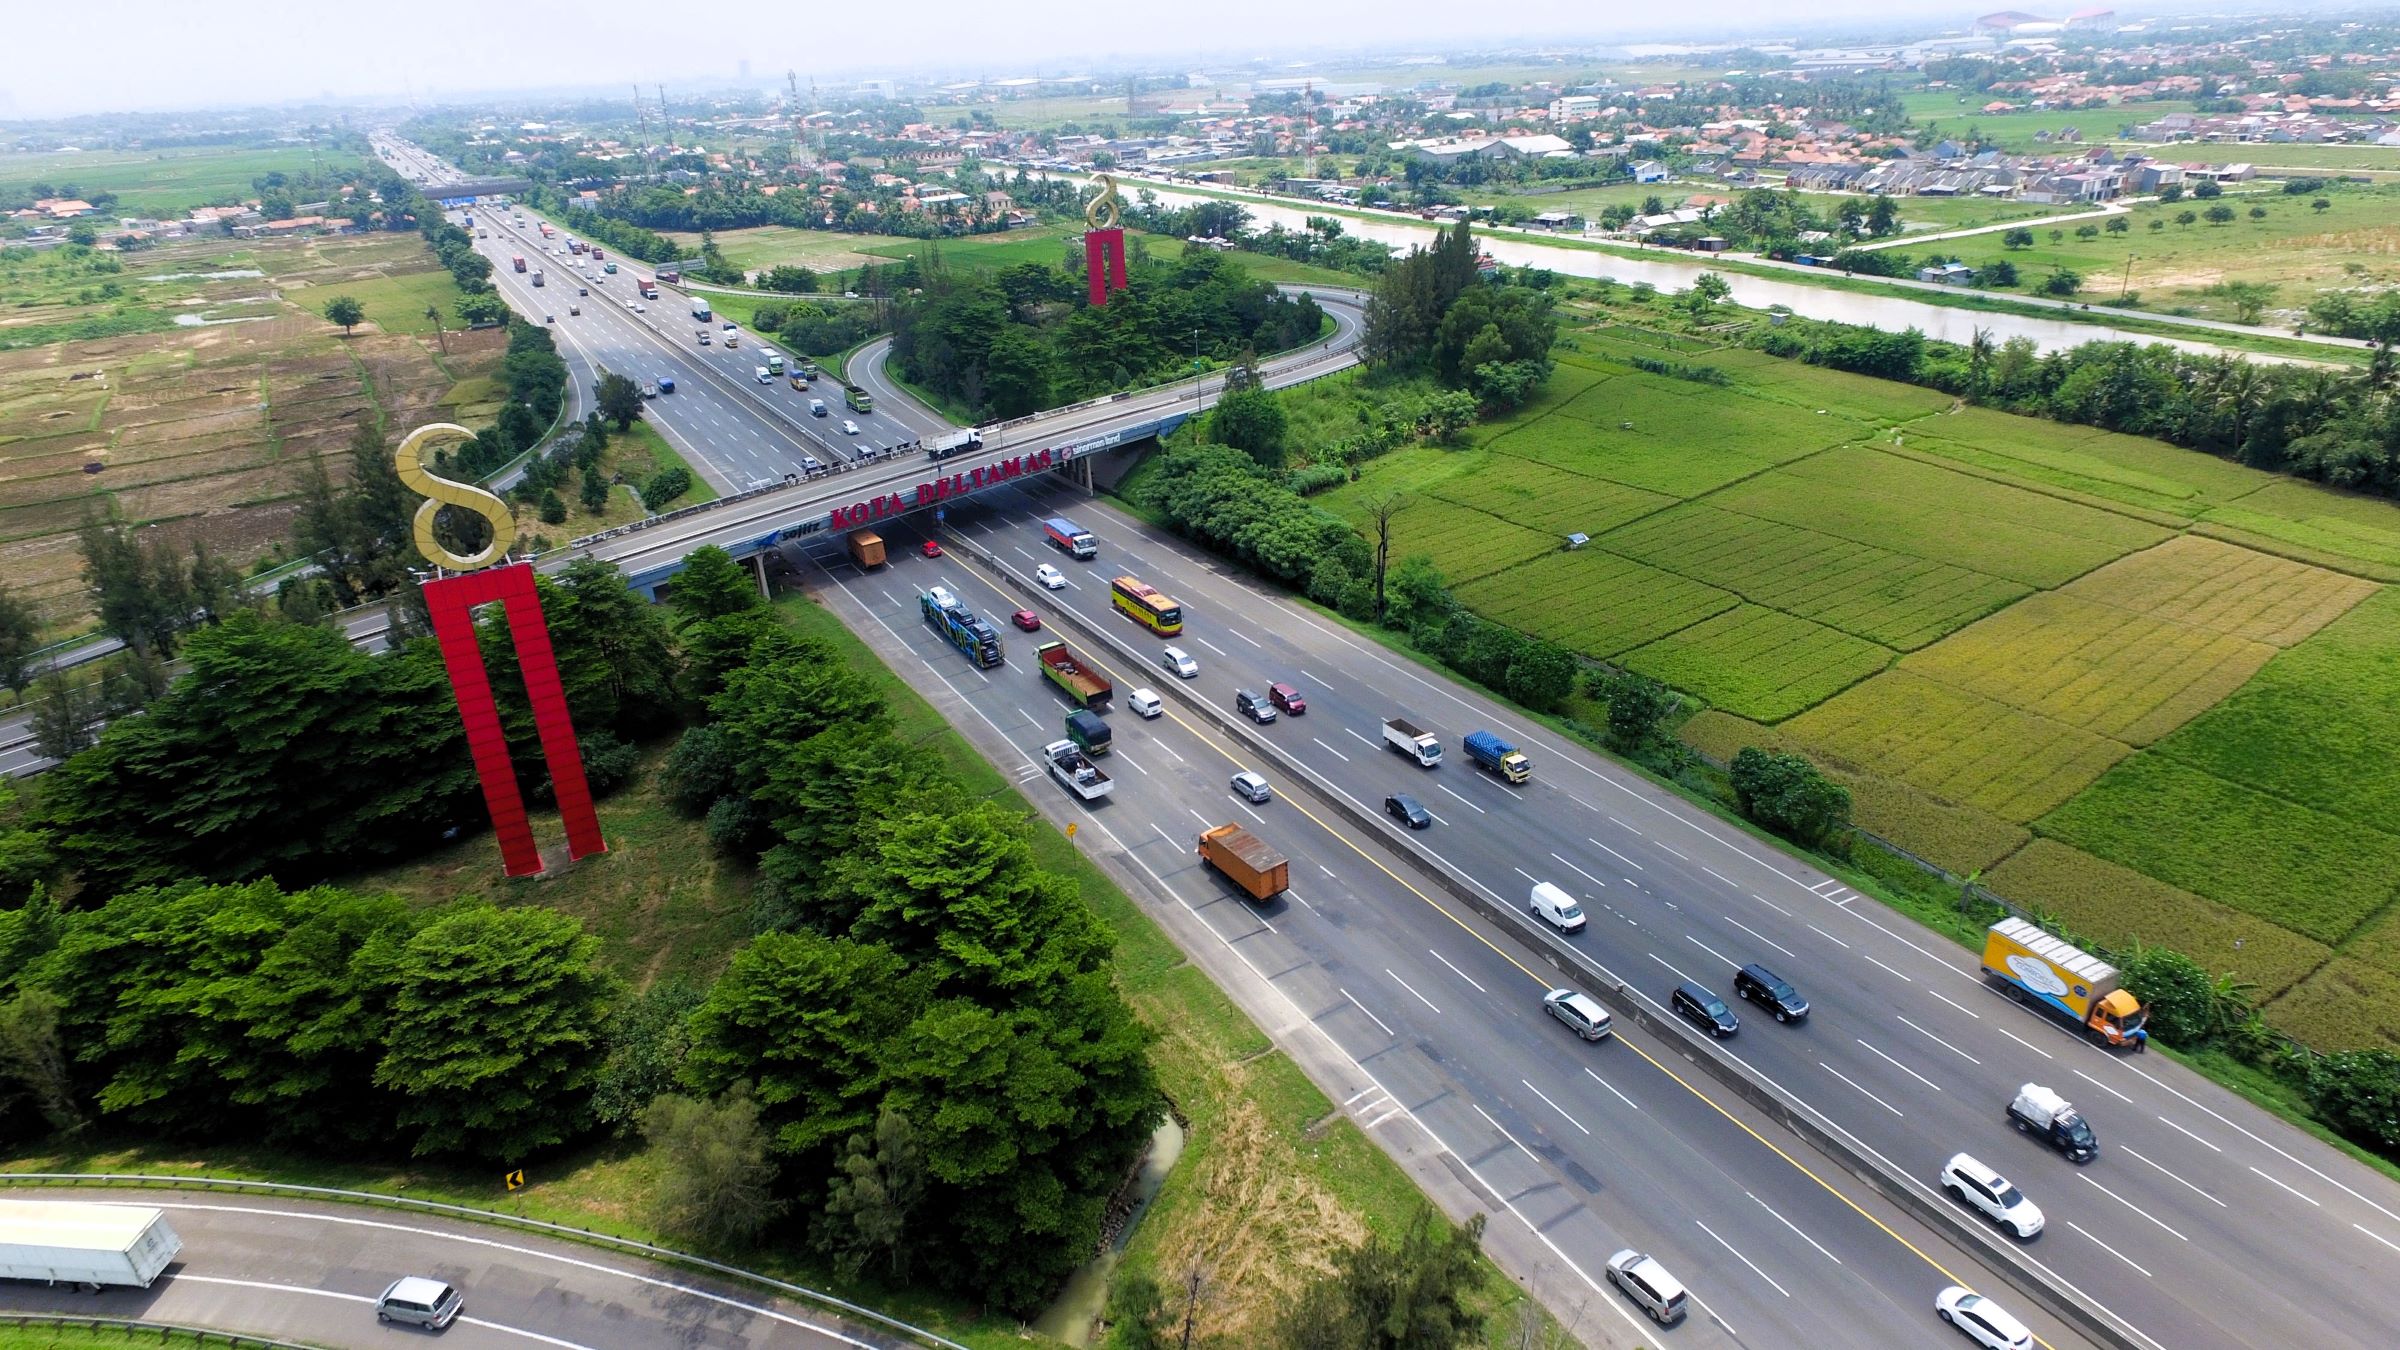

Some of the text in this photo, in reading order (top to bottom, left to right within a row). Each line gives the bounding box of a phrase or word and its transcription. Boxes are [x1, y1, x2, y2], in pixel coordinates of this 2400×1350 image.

[1105, 432, 1121, 446] land
[830, 448, 1052, 531] KOTA DELTAMAS
[782, 522, 820, 541] sojitz
